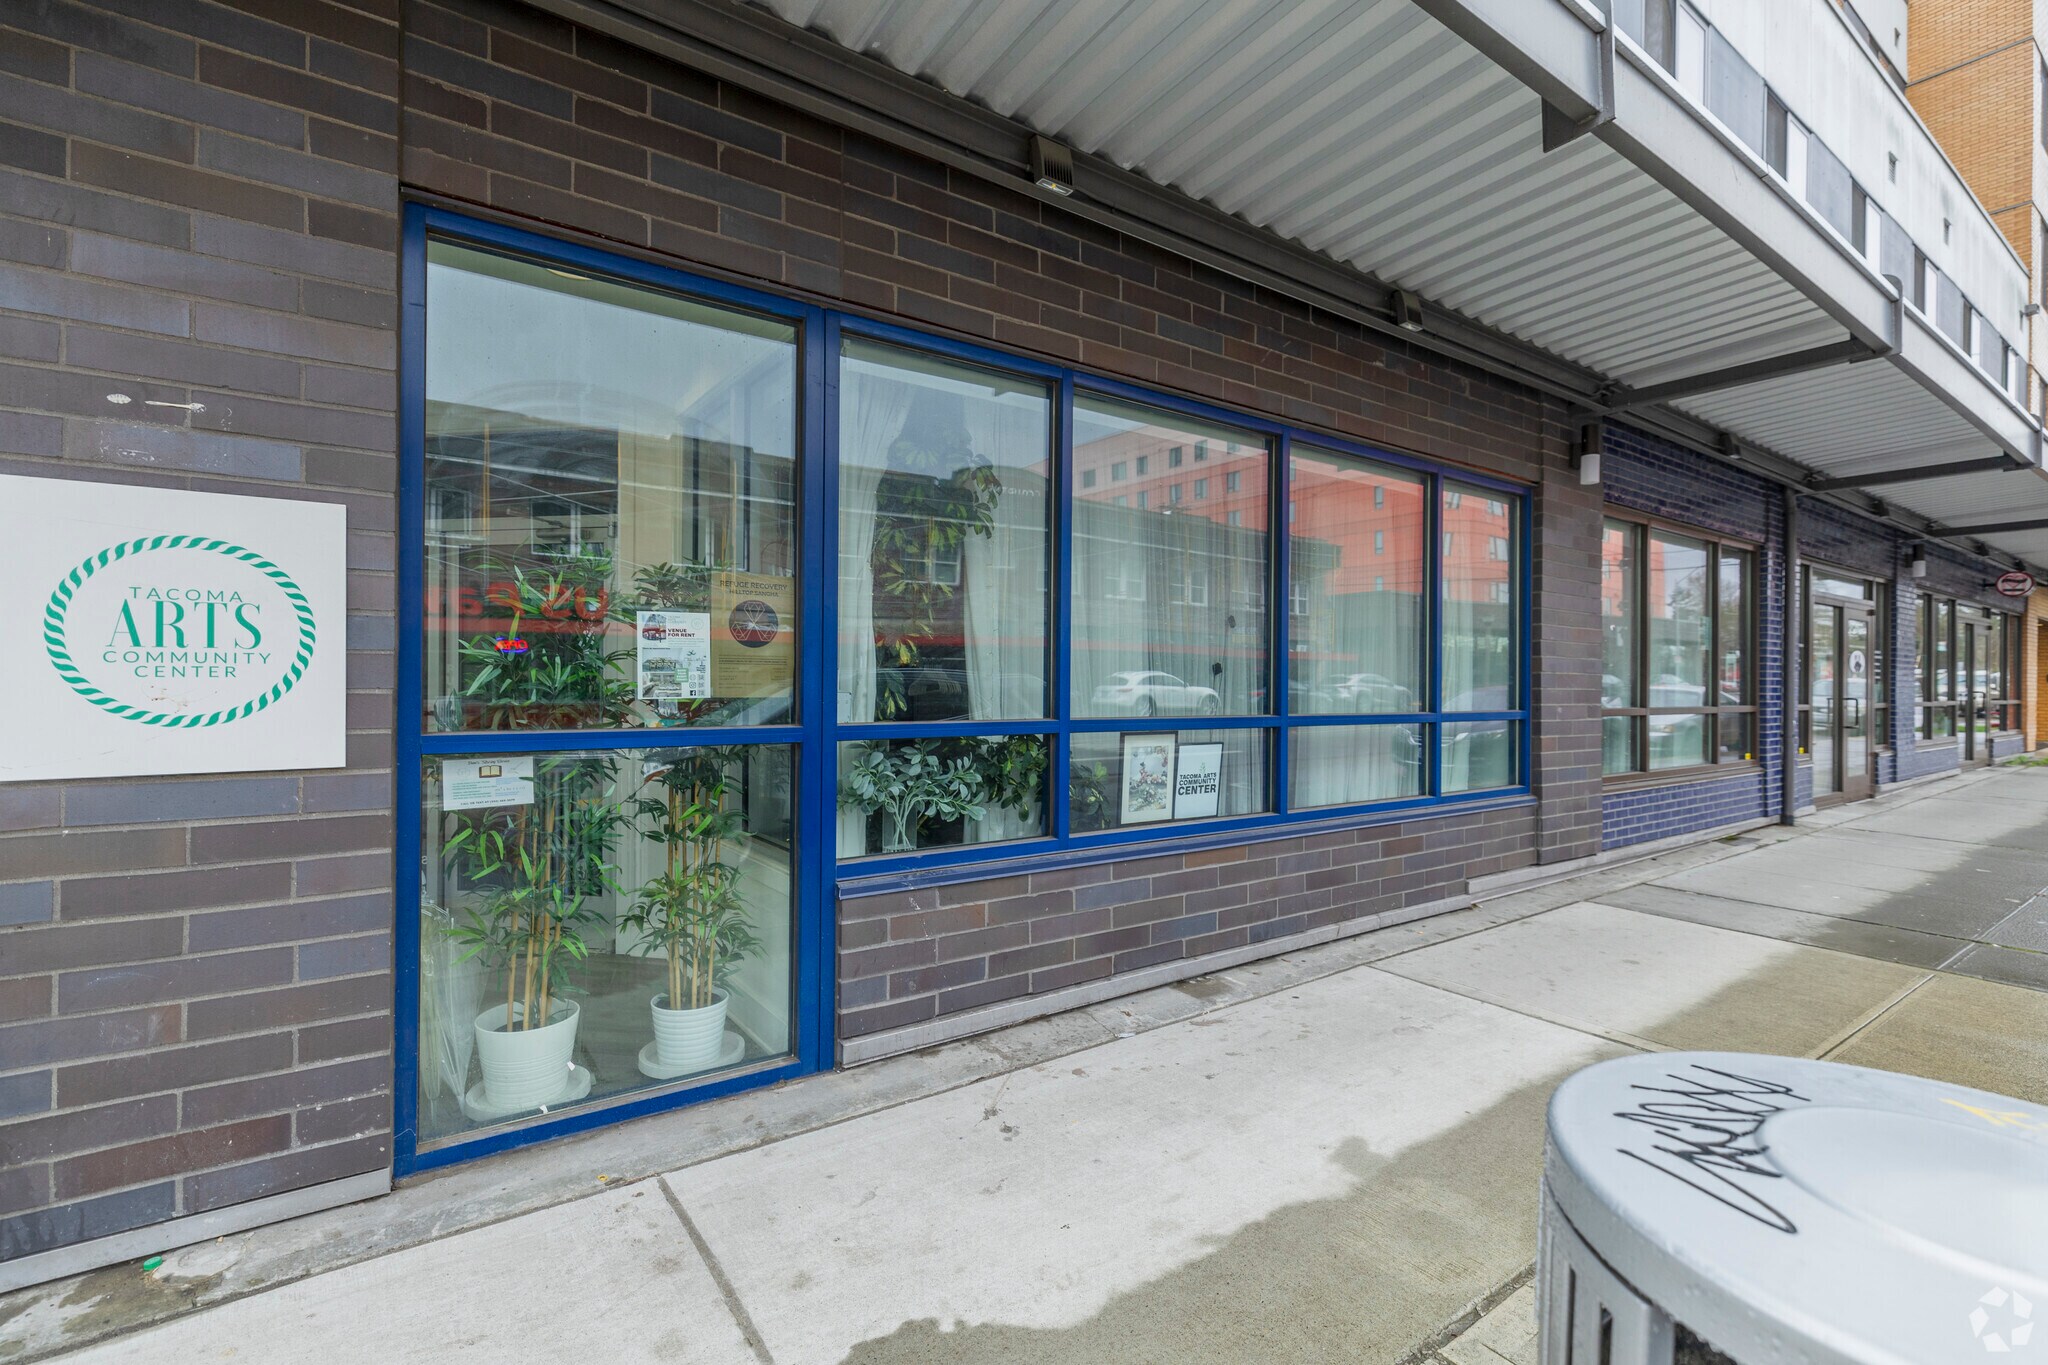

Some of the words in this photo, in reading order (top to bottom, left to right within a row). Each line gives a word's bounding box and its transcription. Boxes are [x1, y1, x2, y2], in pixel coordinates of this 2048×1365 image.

[720, 580, 749, 588] REFUGE
[751, 582, 788, 591] RECOVERY
[128, 586, 243, 603] TACOMA
[105, 599, 262, 650] ARTS
[102, 651, 271, 665] COMMUNITY
[134, 665, 237, 678] CENTER
[1178, 784, 1216, 796] CENTER
